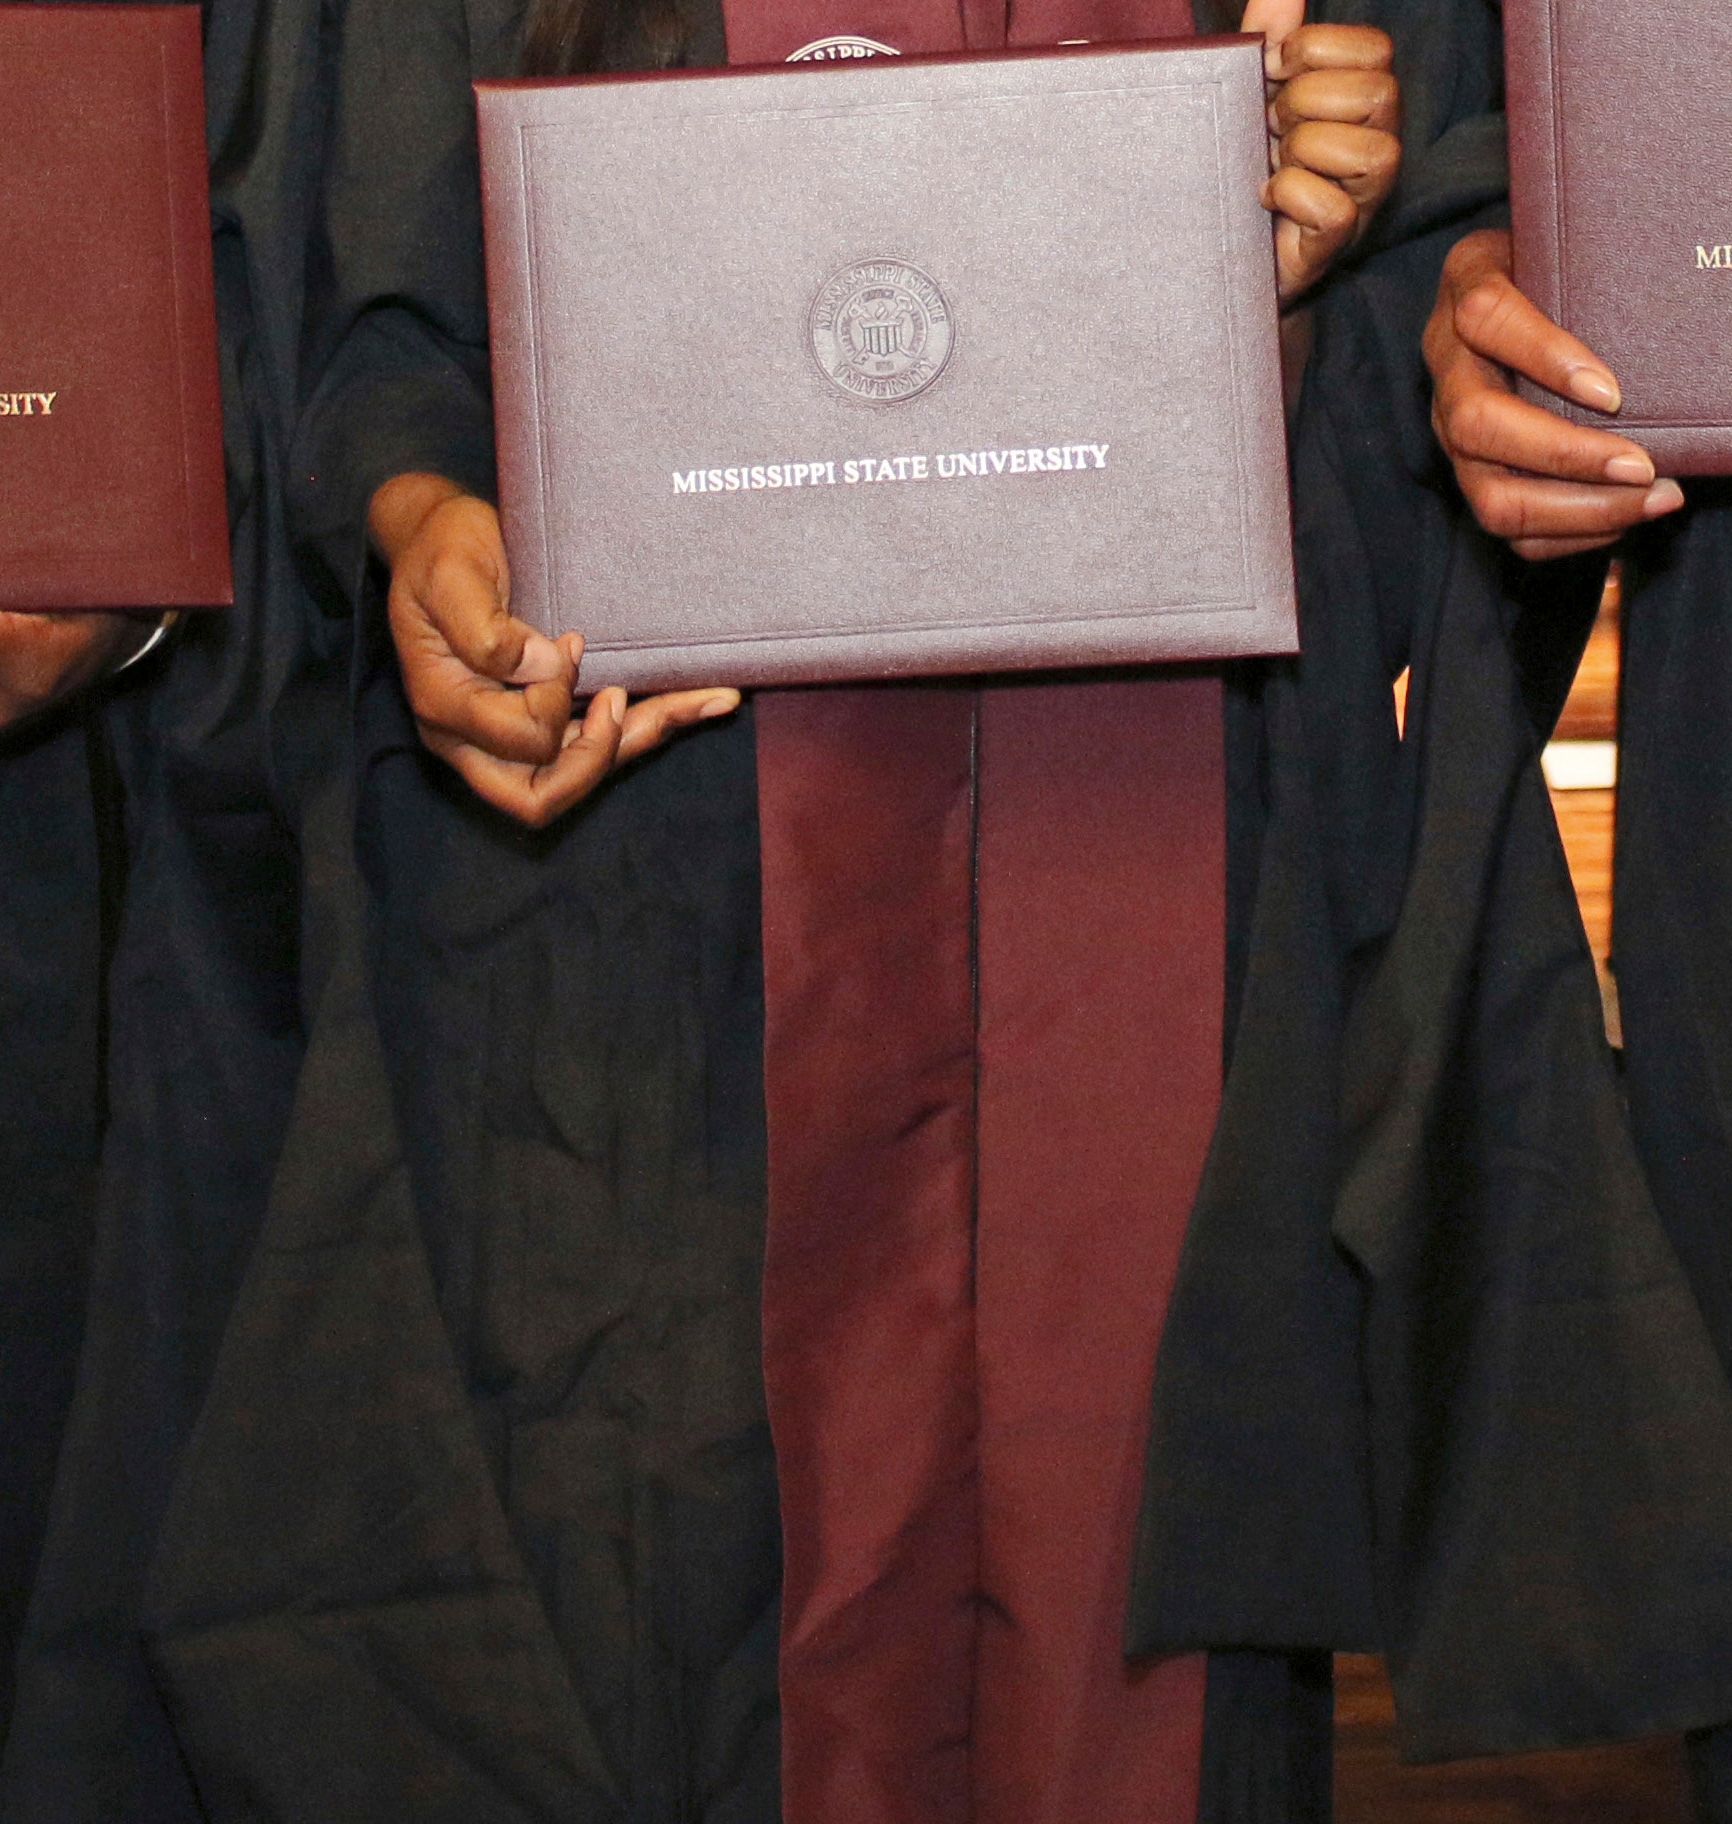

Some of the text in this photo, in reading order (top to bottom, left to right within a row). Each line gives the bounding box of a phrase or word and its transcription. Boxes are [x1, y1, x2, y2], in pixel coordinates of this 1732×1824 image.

[672, 444, 1110, 494] MISSISSIPPI STATE UNIVERSITY
